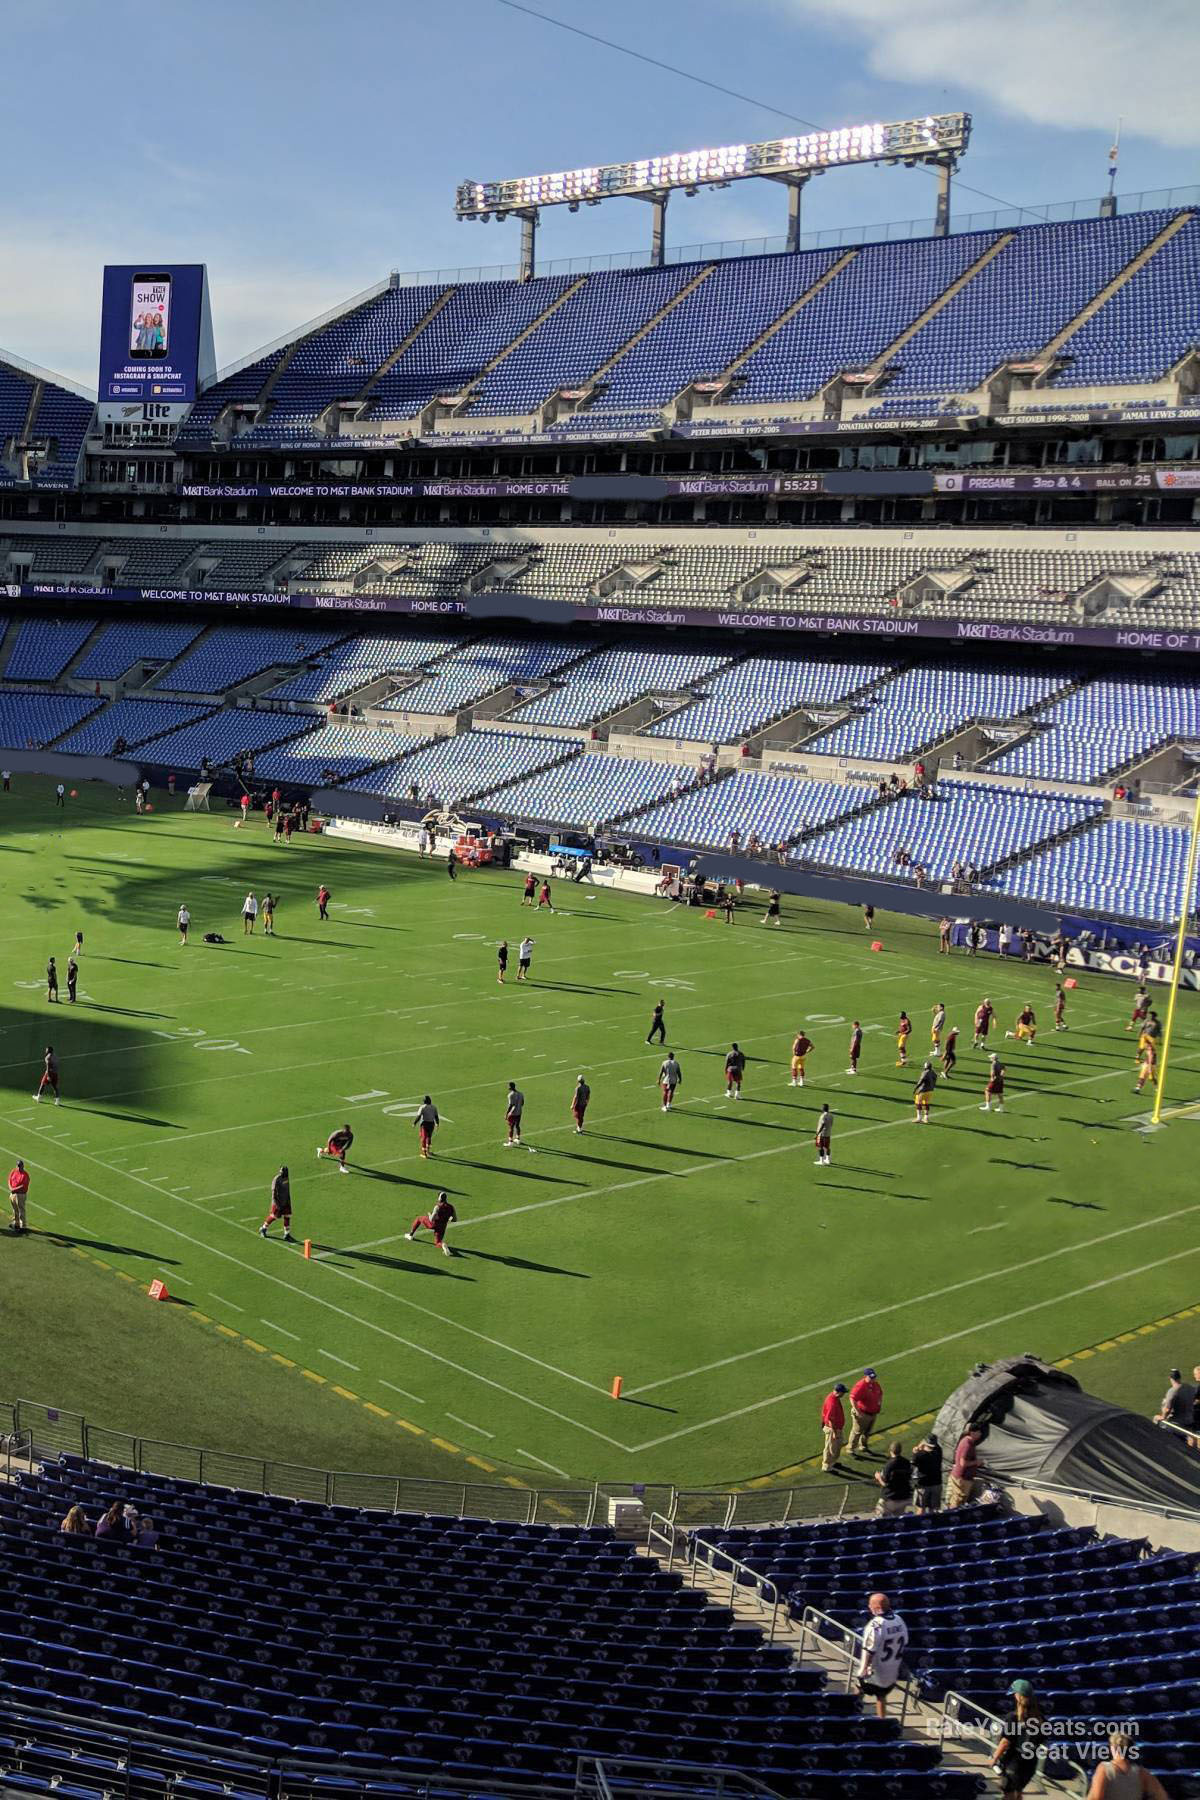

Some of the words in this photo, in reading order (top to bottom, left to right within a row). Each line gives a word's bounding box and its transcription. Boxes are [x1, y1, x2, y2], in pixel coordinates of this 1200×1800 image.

[137, 294, 165, 303] SHOW
[142, 403, 171, 421] Lite
[1121, 412, 1148, 420] JAMAL
[1150, 410, 1176, 419] LEWIS
[1016, 415, 1045, 423] STOVER
[691, 428, 711, 436] PETER
[712, 427, 745, 435] BOULWARE
[837, 422, 873, 431] JONATHAN
[874, 421, 899, 430] OGDEN
[784, 481, 818, 491] 55:23
[946, 478, 955, 489] 0
[968, 478, 1015, 489] PREGAME
[1057, 476, 1068, 488] &
[1071, 476, 1080, 488] 4
[1096, 479, 1116, 487] BALL
[1134, 475, 1151, 486] 25
[182, 486, 203, 495] M&T
[204, 486, 223, 495] Bank
[224, 486, 258, 496] Stadium
[270, 487, 314, 496] WELCOME
[316, 487, 328, 495] TO
[330, 487, 349, 495] M&T
[351, 487, 375, 495] BANK
[377, 486, 412, 495] STADIUM
[423, 485, 443, 496] M&T
[444, 485, 463, 495] Bank
[463, 485, 496, 495] Stadium
[506, 484, 533, 494] HOME
[535, 484, 548, 494] OF
[551, 484, 569, 493] THE
[679, 482, 704, 493] M&T
[704, 482, 729, 493] Bank
[729, 481, 768, 493] Stadium
[141, 589, 187, 599] WELCOME
[189, 591, 202, 600] TO
[204, 592, 224, 600] M&T
[227, 593, 250, 602] BANK
[252, 593, 291, 604] STADIUM
[315, 597, 335, 607] M&T
[336, 598, 355, 608] Bank
[355, 598, 386, 610] Stadium
[411, 601, 438, 611] HOME
[440, 602, 453, 611] OF
[456, 602, 467, 612] TH
[597, 607, 622, 620] M&T
[622, 609, 645, 621] Bank
[646, 609, 685, 623] Stadium
[718, 614, 776, 627] WELCOME
[779, 616, 795, 628] TO
[799, 617, 824, 629] M&T
[827, 618, 860, 630] BANK
[863, 620, 918, 633] STADIUM
[957, 623, 990, 637] M&T
[990, 625, 1021, 639] Bank
[1021, 626, 1074, 643] Stadium
[1116, 631, 1162, 646] HOME
[1166, 634, 1189, 648] OF
